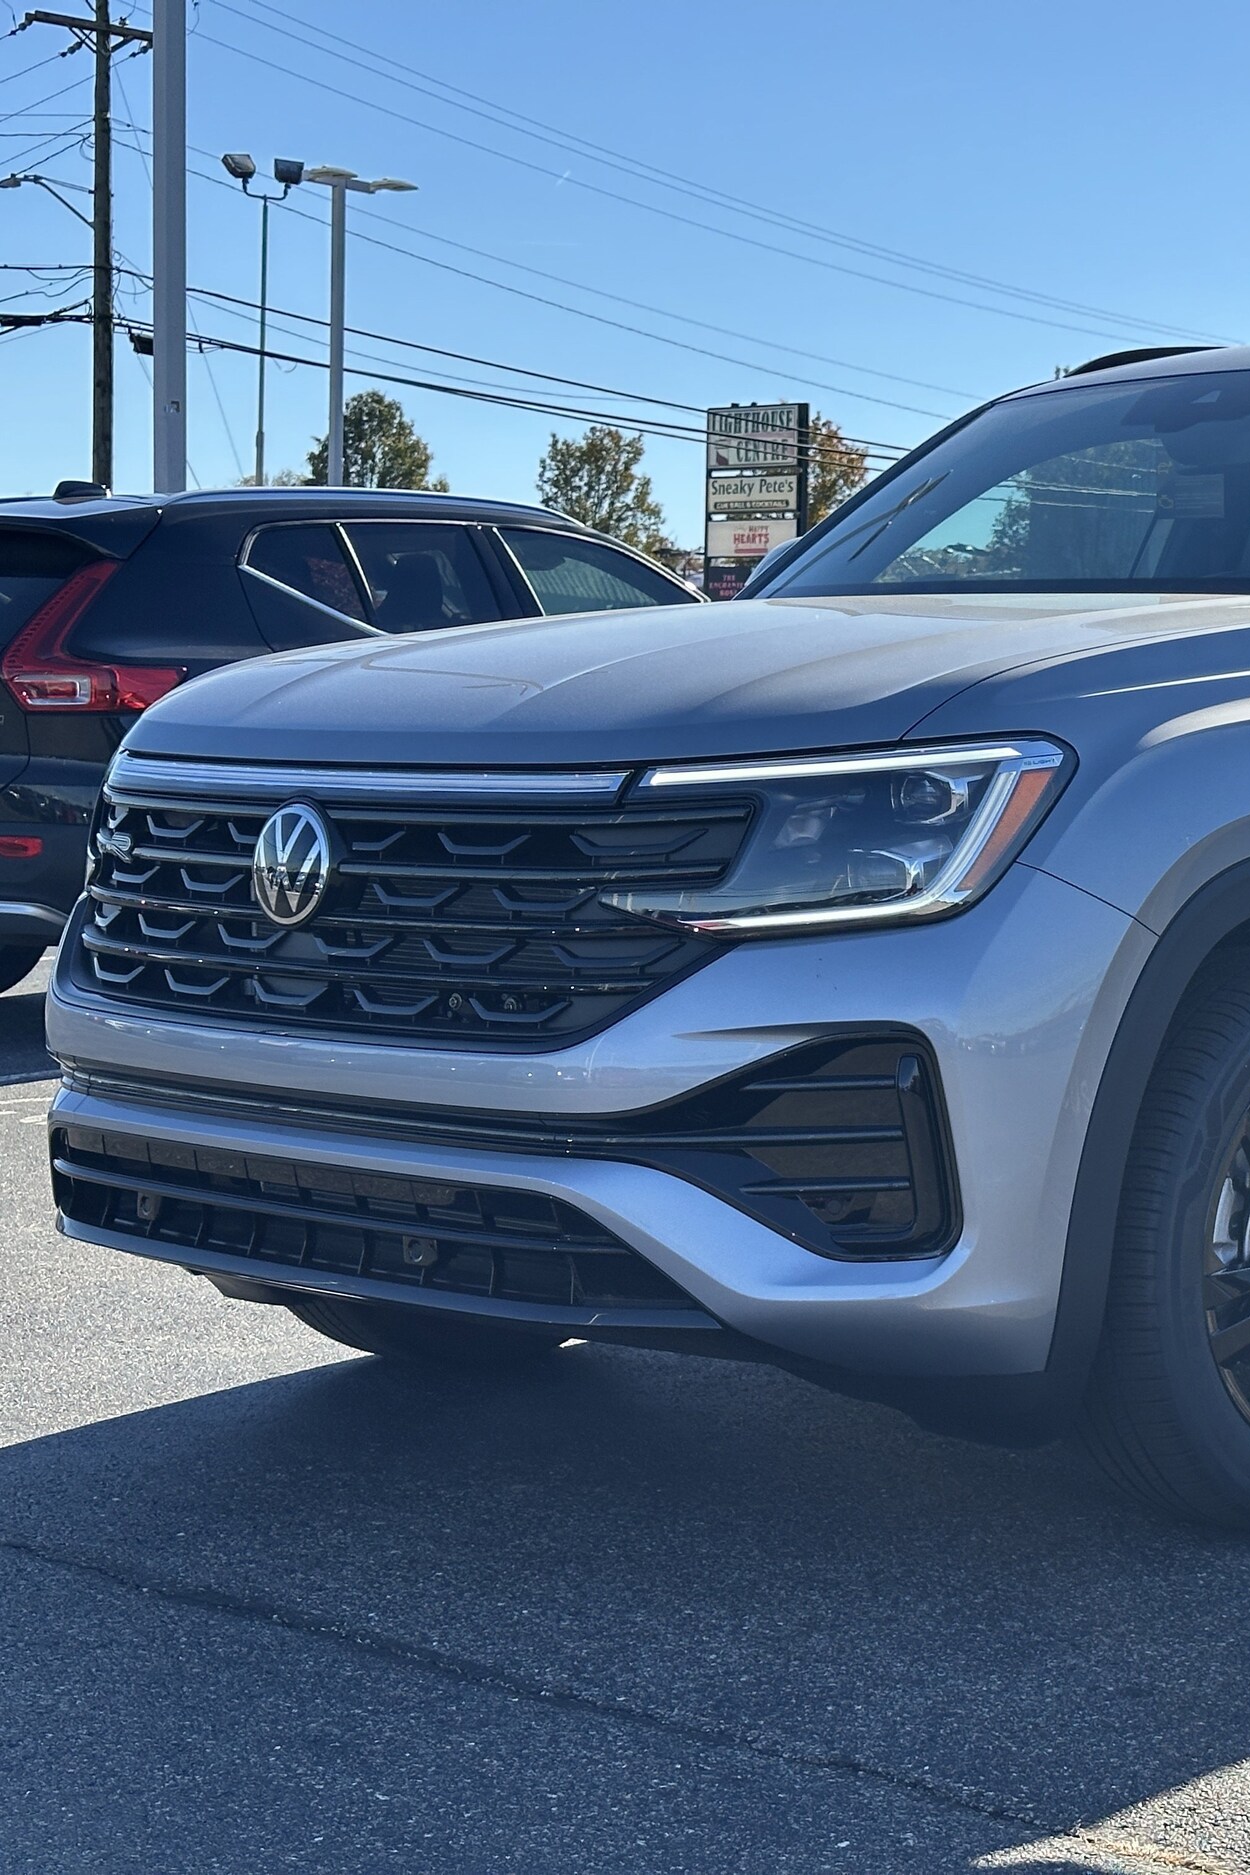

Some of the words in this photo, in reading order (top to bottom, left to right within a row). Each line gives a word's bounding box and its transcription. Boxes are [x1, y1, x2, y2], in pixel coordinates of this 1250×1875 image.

[712, 410, 793, 434] LIGHTHOUSE
[736, 439, 788, 462] CENTRE
[711, 479, 755, 497] Sneaky
[759, 478, 794, 494] Pete's
[734, 533, 770, 545] HEARTS
